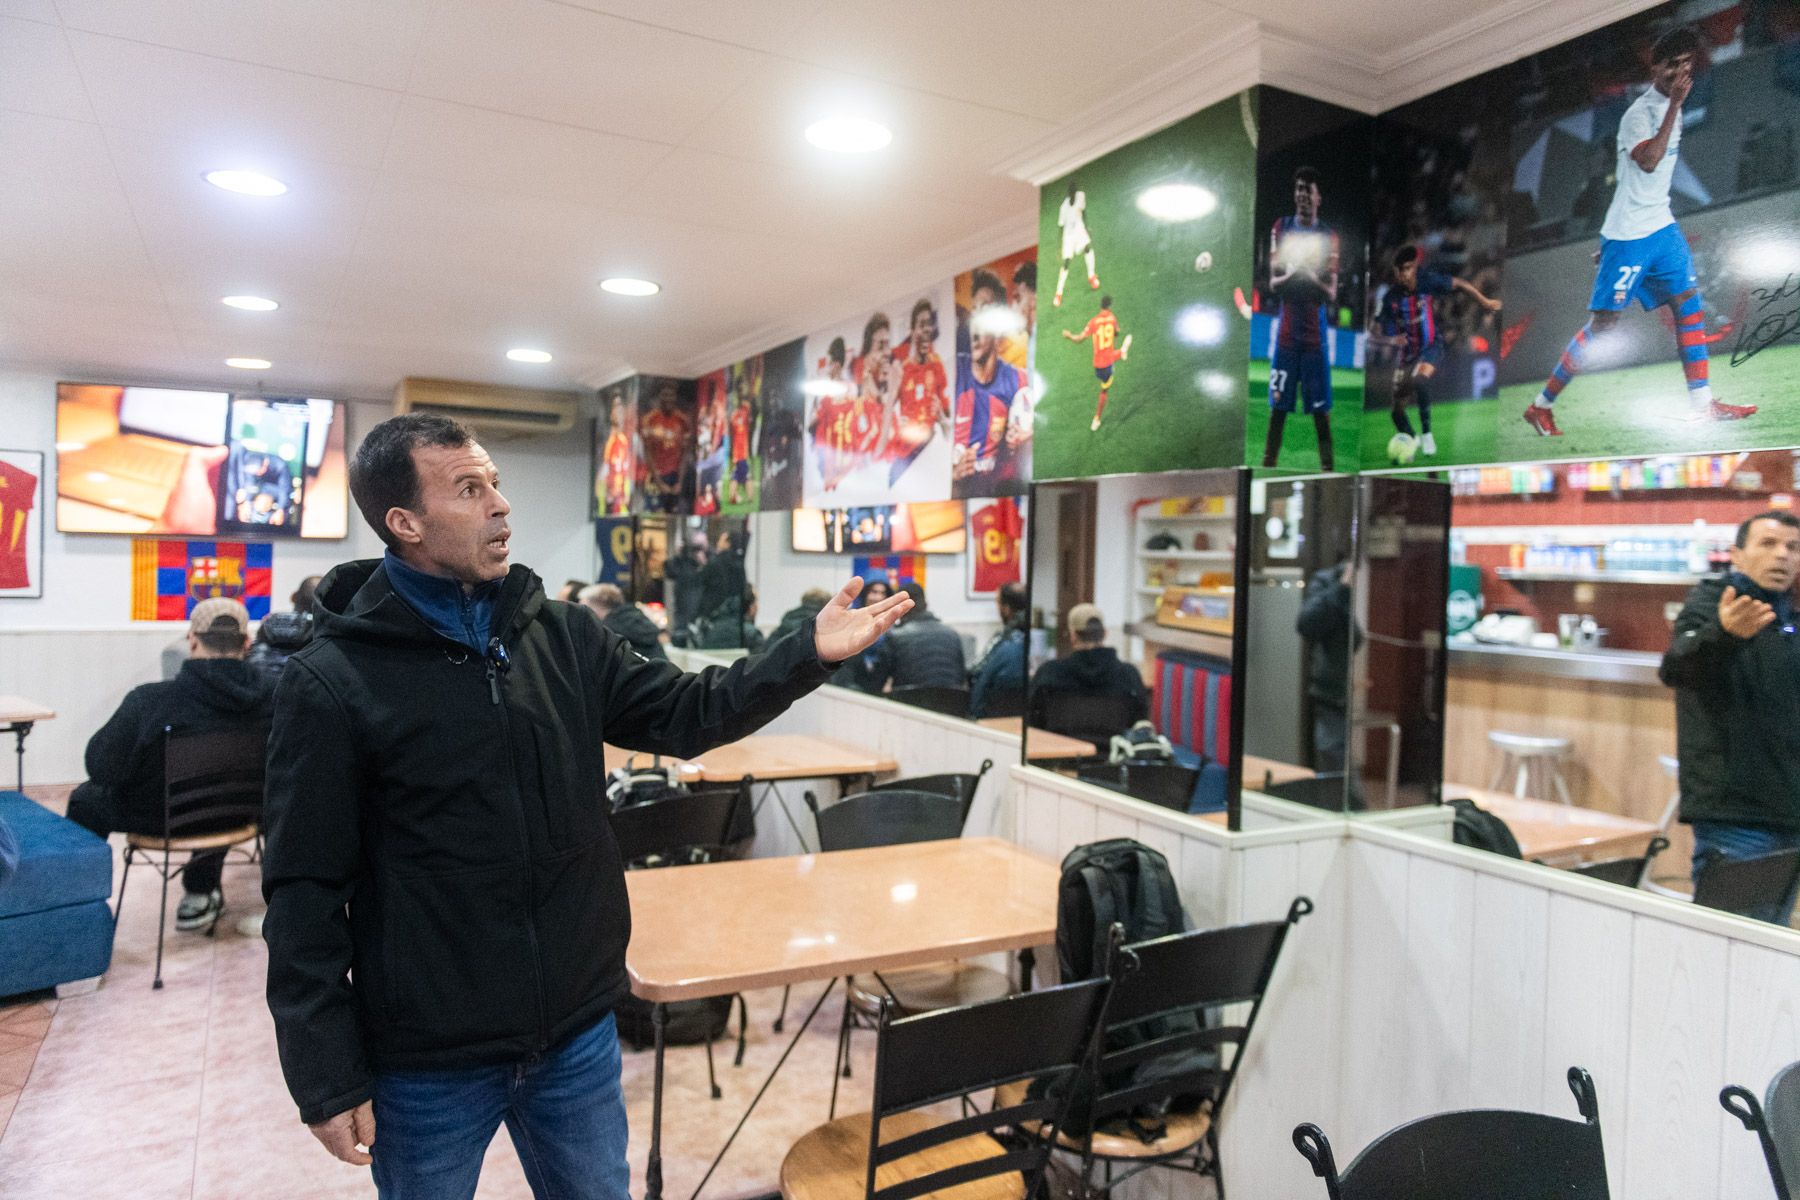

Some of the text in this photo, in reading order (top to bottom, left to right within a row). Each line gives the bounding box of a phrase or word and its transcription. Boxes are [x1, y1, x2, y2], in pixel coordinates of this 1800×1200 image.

[1613, 265, 1642, 290] 27
[1097, 323, 1114, 350] 19
[1270, 369, 1288, 392] 27
[1472, 359, 1496, 400] P
